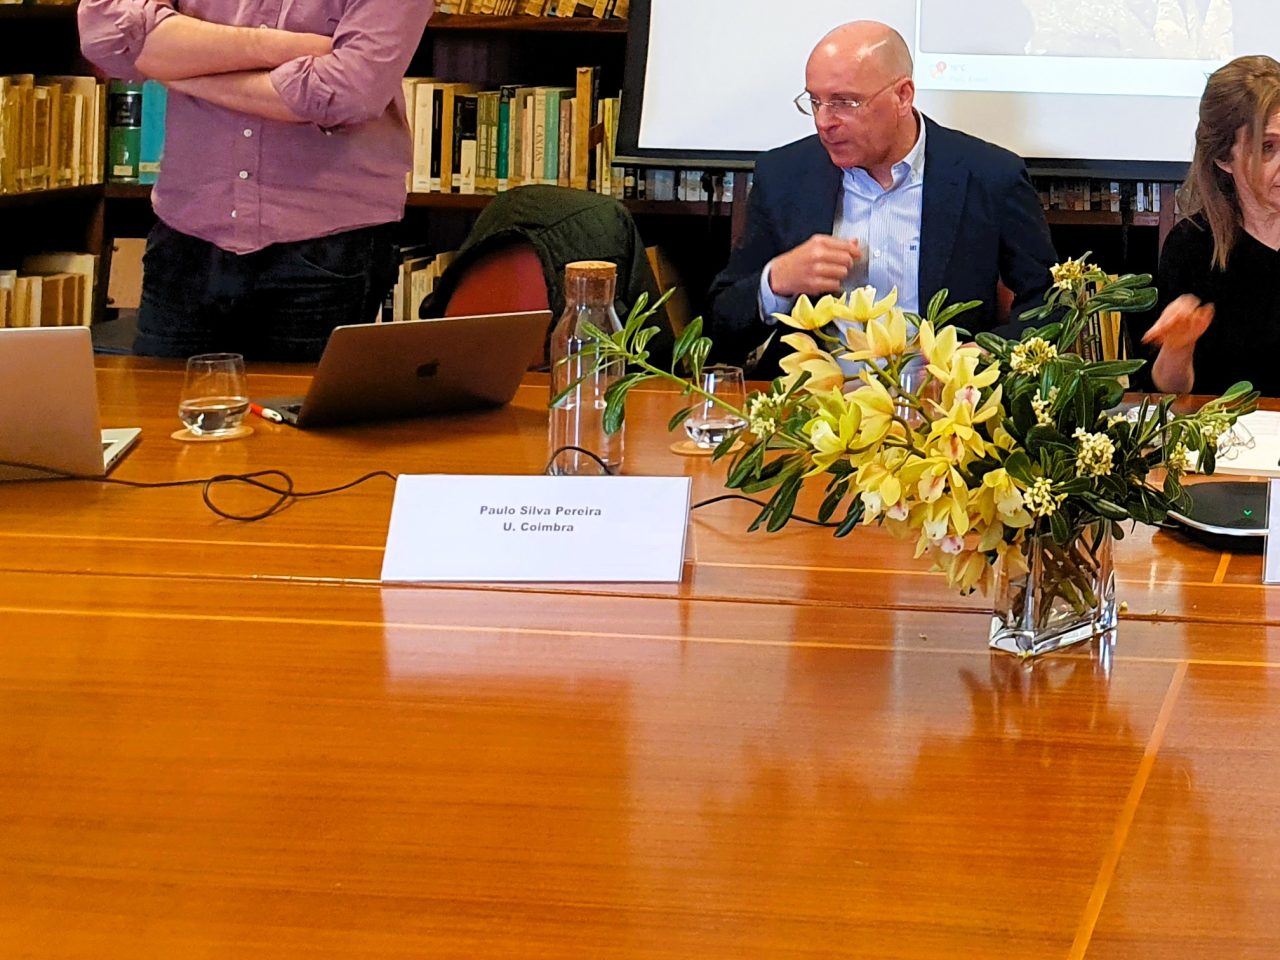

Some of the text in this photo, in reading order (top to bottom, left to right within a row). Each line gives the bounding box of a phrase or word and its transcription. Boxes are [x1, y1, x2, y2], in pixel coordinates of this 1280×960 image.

[479, 505, 602, 516] Paulo Silva Pereira
[503, 522, 574, 532] U. Coimbra
